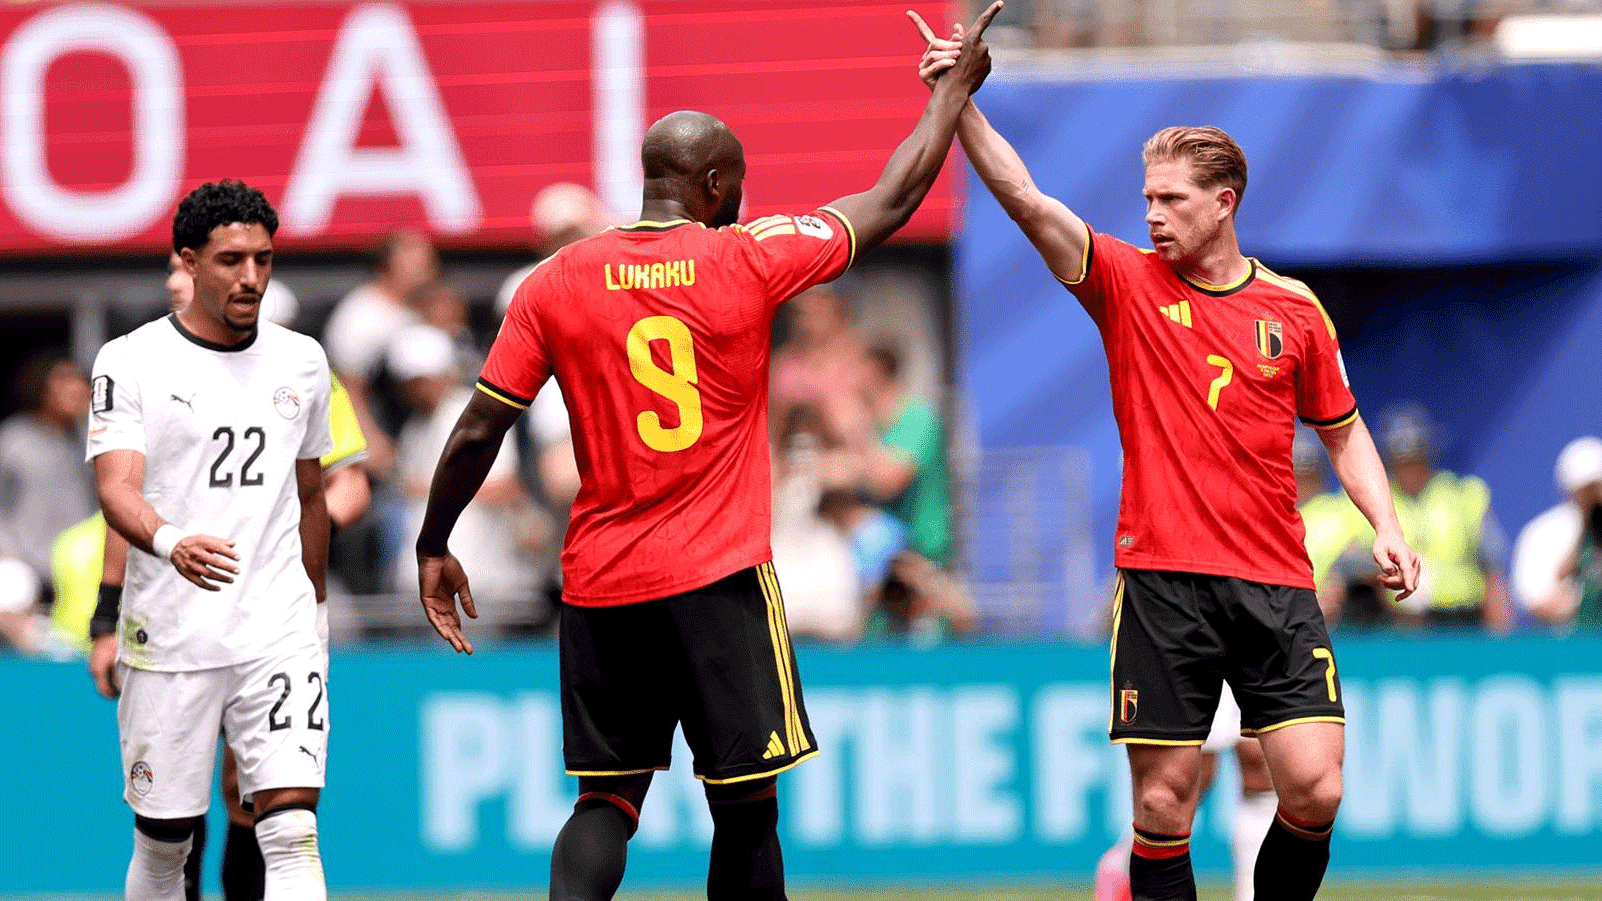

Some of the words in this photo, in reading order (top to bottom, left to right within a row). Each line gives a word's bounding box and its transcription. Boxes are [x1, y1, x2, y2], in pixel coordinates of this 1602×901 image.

[604, 259, 696, 291] LUKAKU
[626, 315, 704, 453] 9
[1206, 354, 1233, 411] 7
[209, 426, 266, 489] 22
[267, 671, 324, 732] 22
[1312, 647, 1337, 703] 7
[798, 688, 1022, 845] THE
